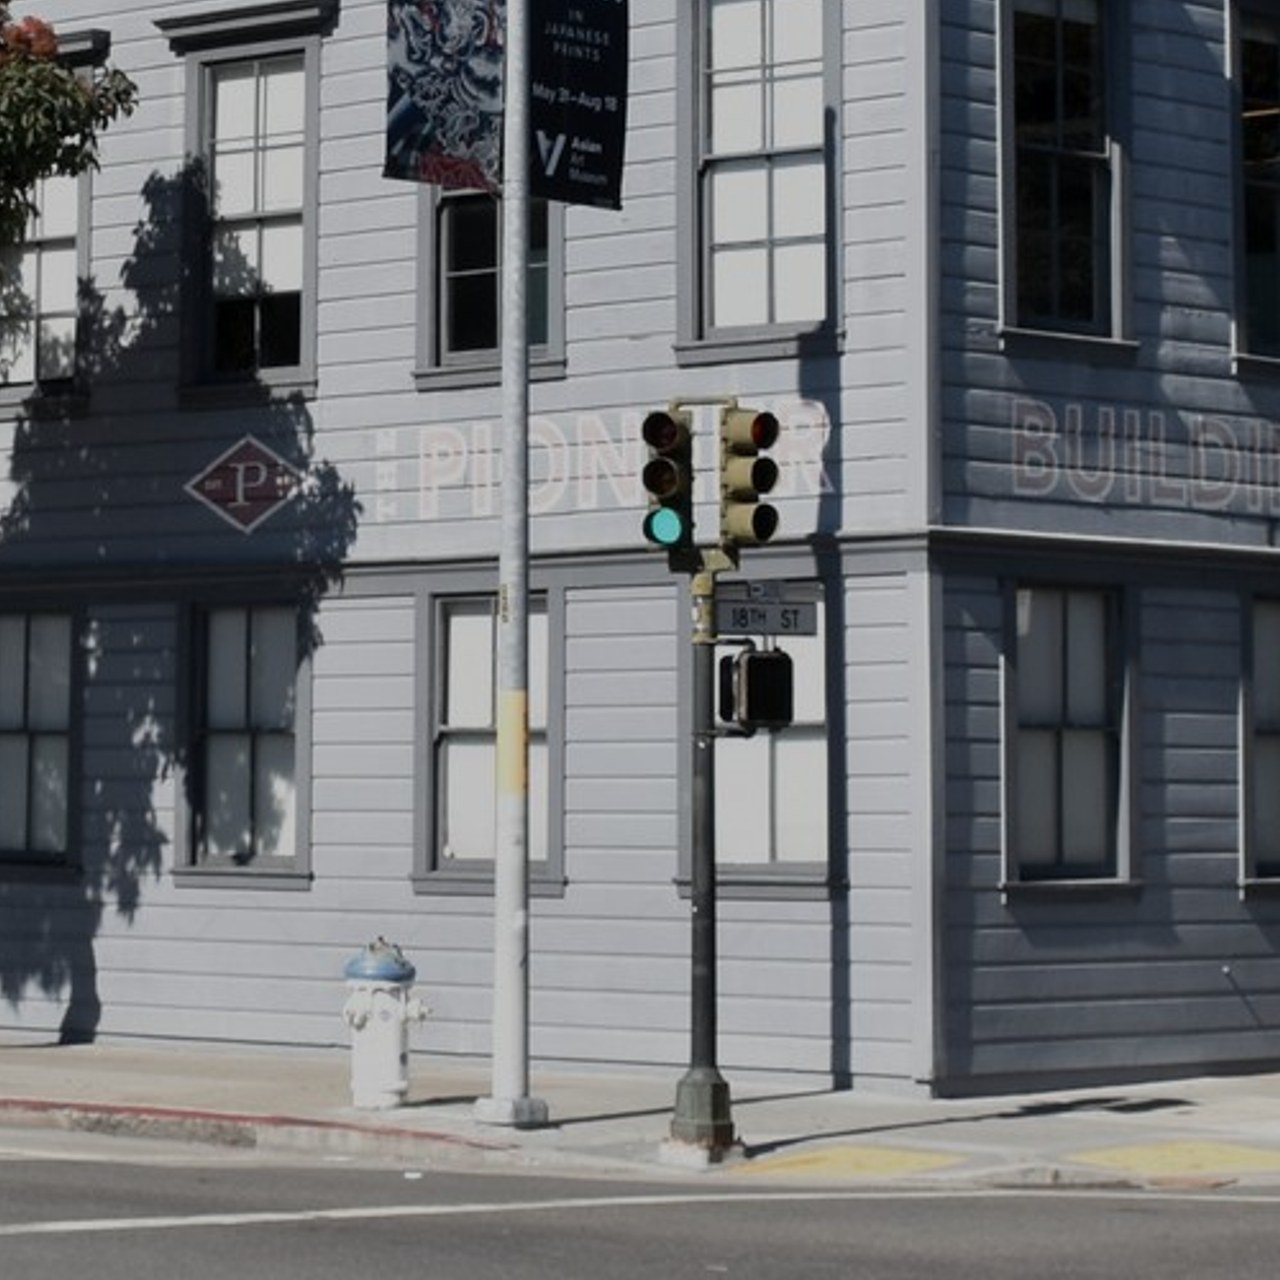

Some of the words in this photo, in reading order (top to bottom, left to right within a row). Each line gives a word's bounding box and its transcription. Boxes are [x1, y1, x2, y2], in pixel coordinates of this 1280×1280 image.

[227, 461, 268, 509] P
[731, 607, 767, 629] 18TH
[780, 608, 800, 631] ST
